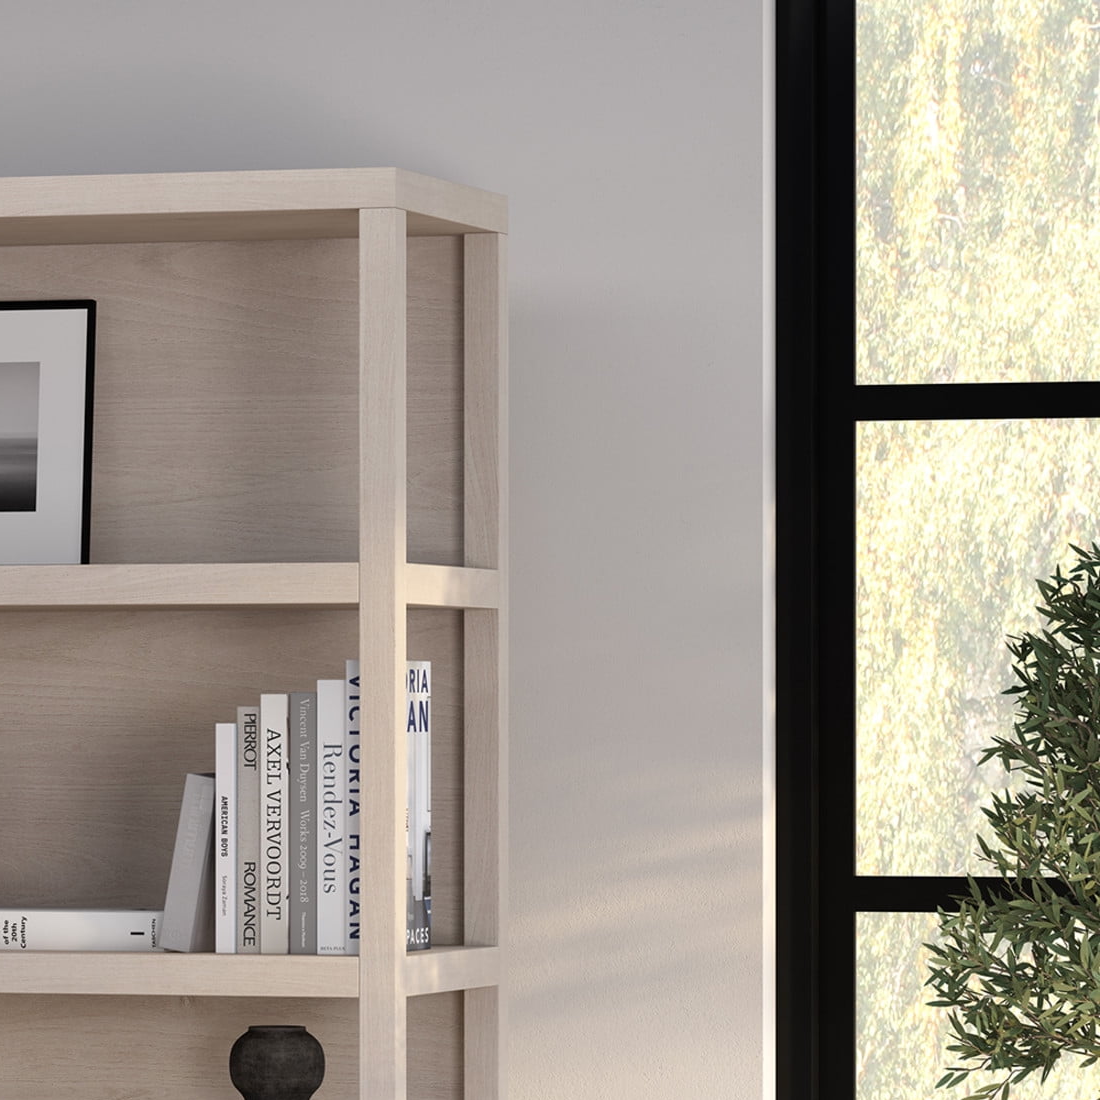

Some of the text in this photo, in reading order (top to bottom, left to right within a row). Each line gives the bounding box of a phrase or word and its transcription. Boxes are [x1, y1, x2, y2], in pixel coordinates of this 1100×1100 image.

[406, 669, 429, 693] RIA
[299, 698, 310, 738] Vincent
[243, 713, 257, 770] PIERROT
[299, 739, 310, 761] Van
[296, 762, 310, 803] Duysen
[221, 795, 229, 857] AMERICAN BOYS
[266, 727, 282, 920] AXEL VERVOORDT
[299, 809, 310, 844] Works
[322, 741, 343, 894] Rendez-Vous
[298, 845, 308, 870] 2009
[243, 861, 257, 947] ROMANCE
[300, 881, 308, 904] 2018
[3, 935, 9, 945] of
